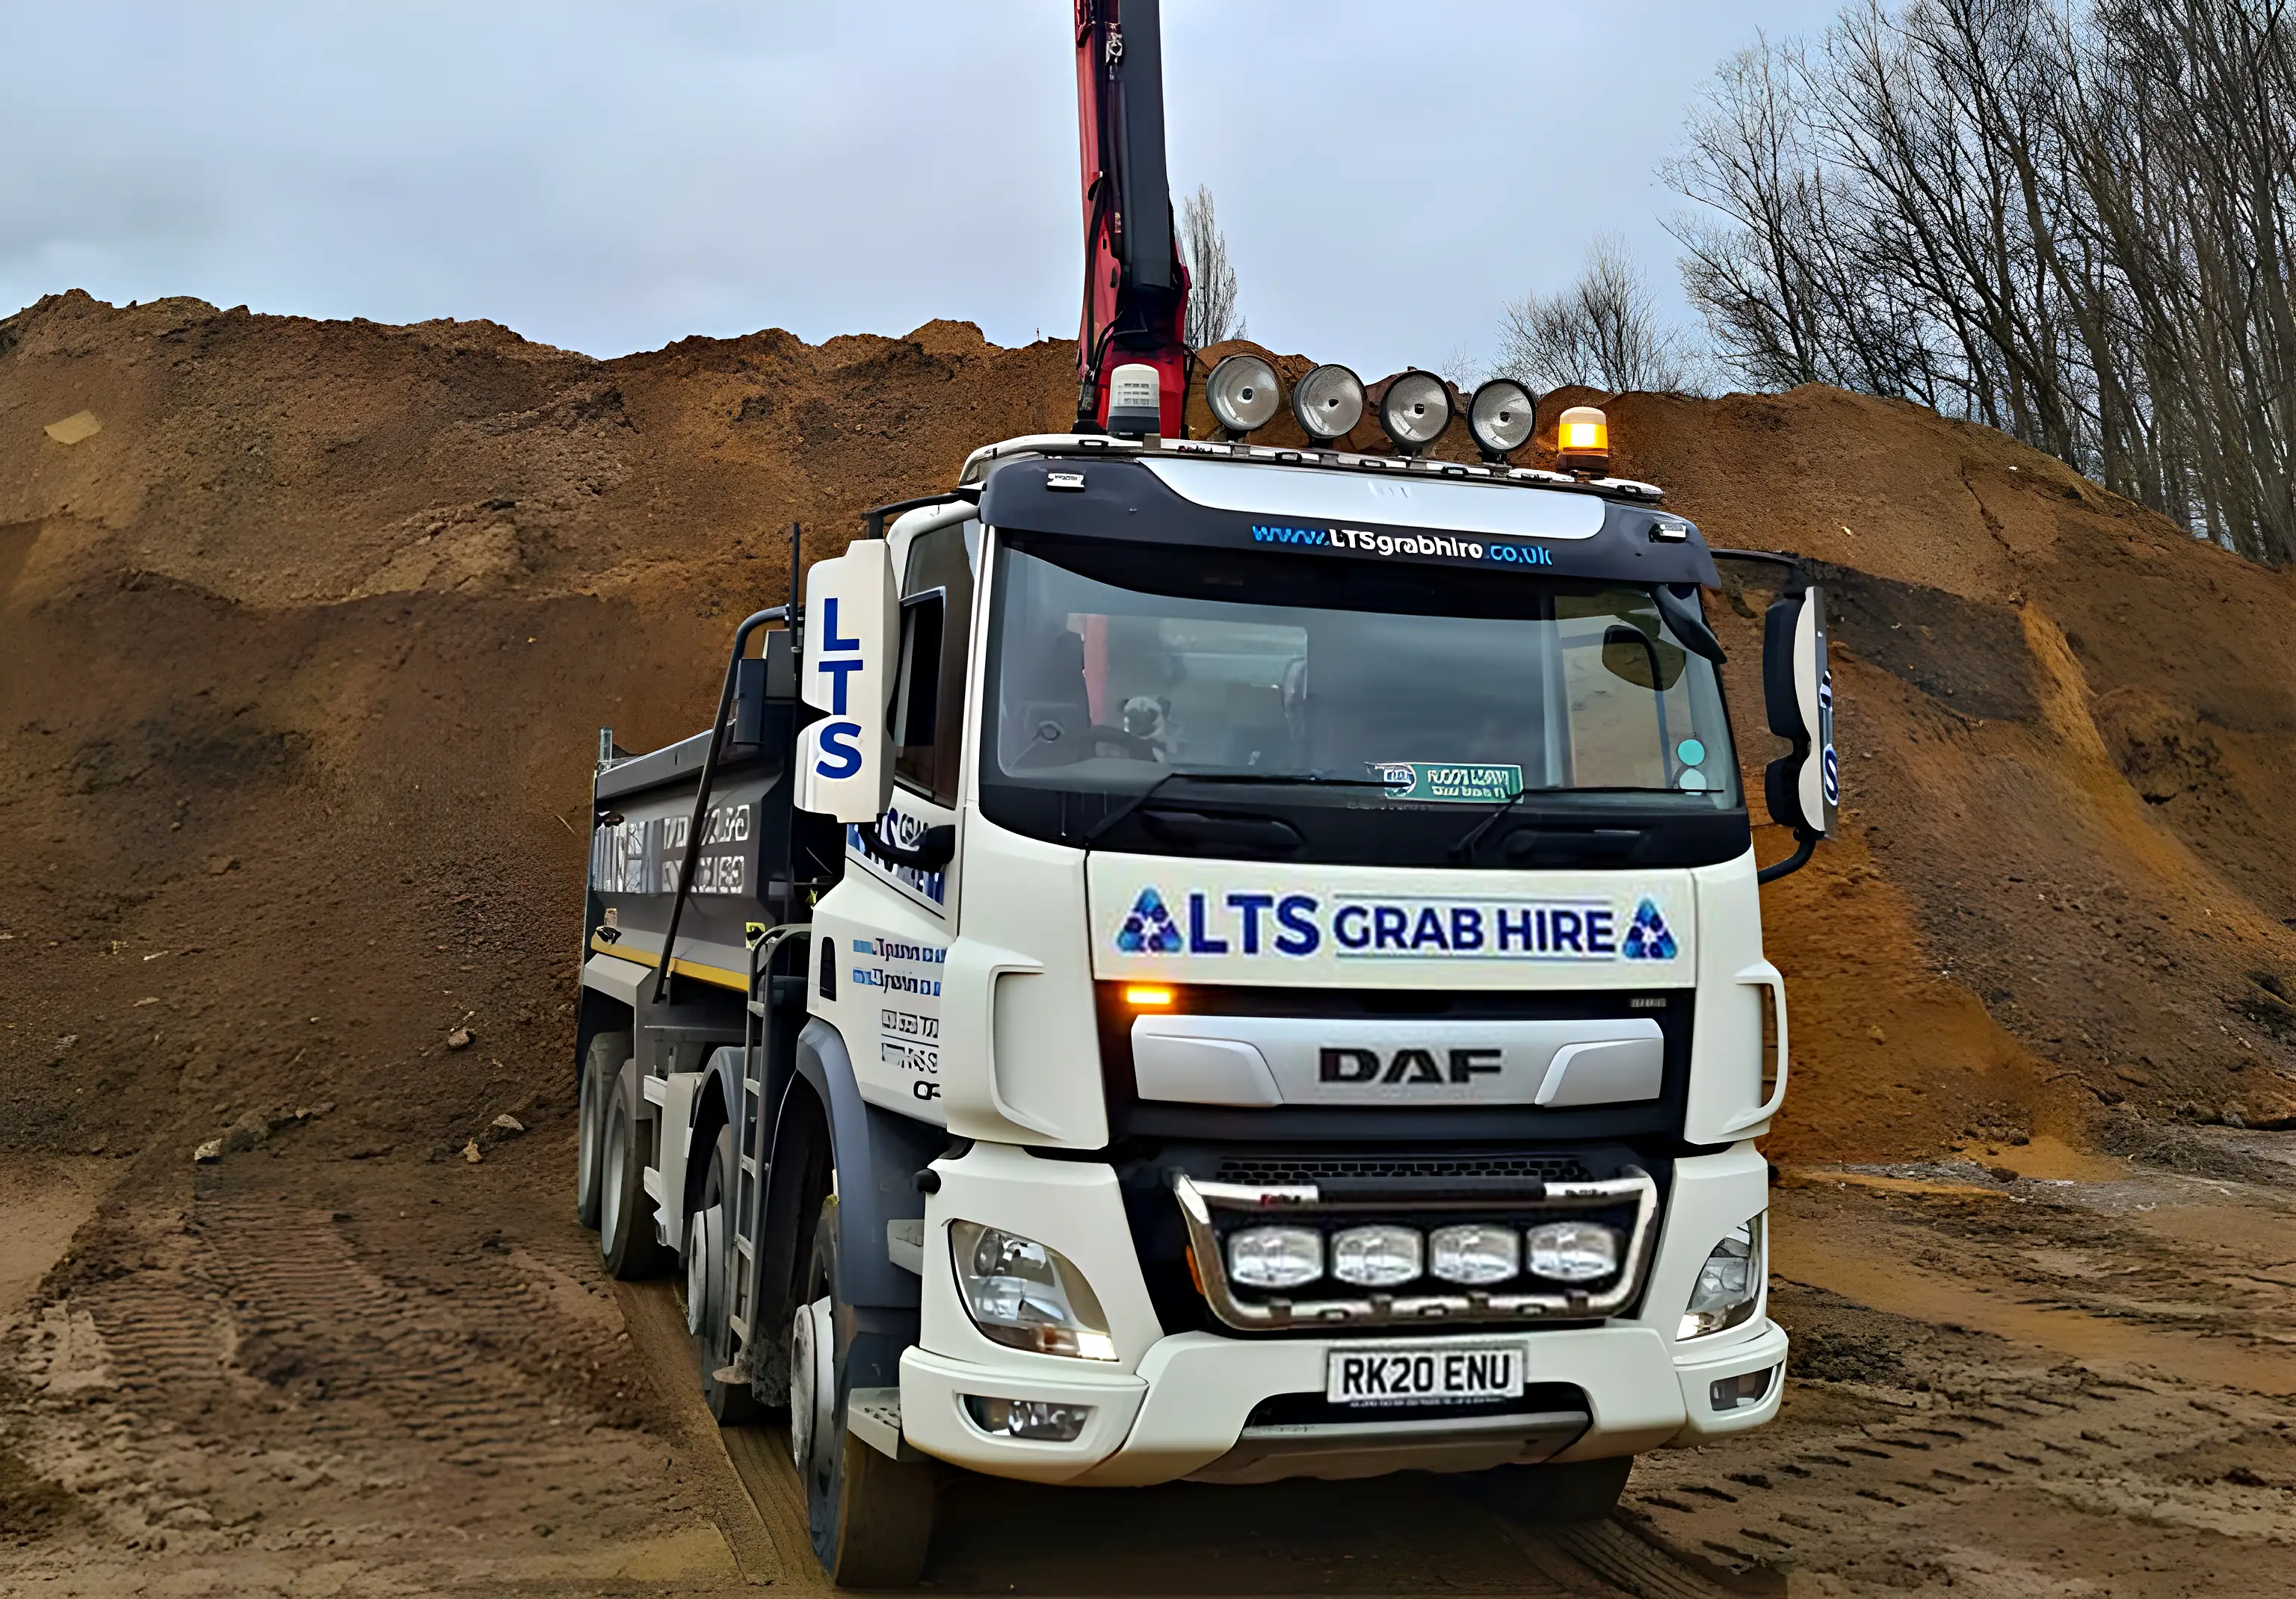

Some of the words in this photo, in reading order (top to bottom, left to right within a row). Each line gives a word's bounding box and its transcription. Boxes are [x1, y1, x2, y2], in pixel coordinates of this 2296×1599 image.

[815, 597, 863, 779] LTS
[1189, 893, 1320, 955] LTS
[1333, 906, 1484, 951] GRAB
[1498, 909, 1616, 953] HIRE
[1319, 1047, 1502, 1083] DAF
[1343, 1356, 1434, 1394] RK20
[1444, 1354, 1510, 1391] ENU
